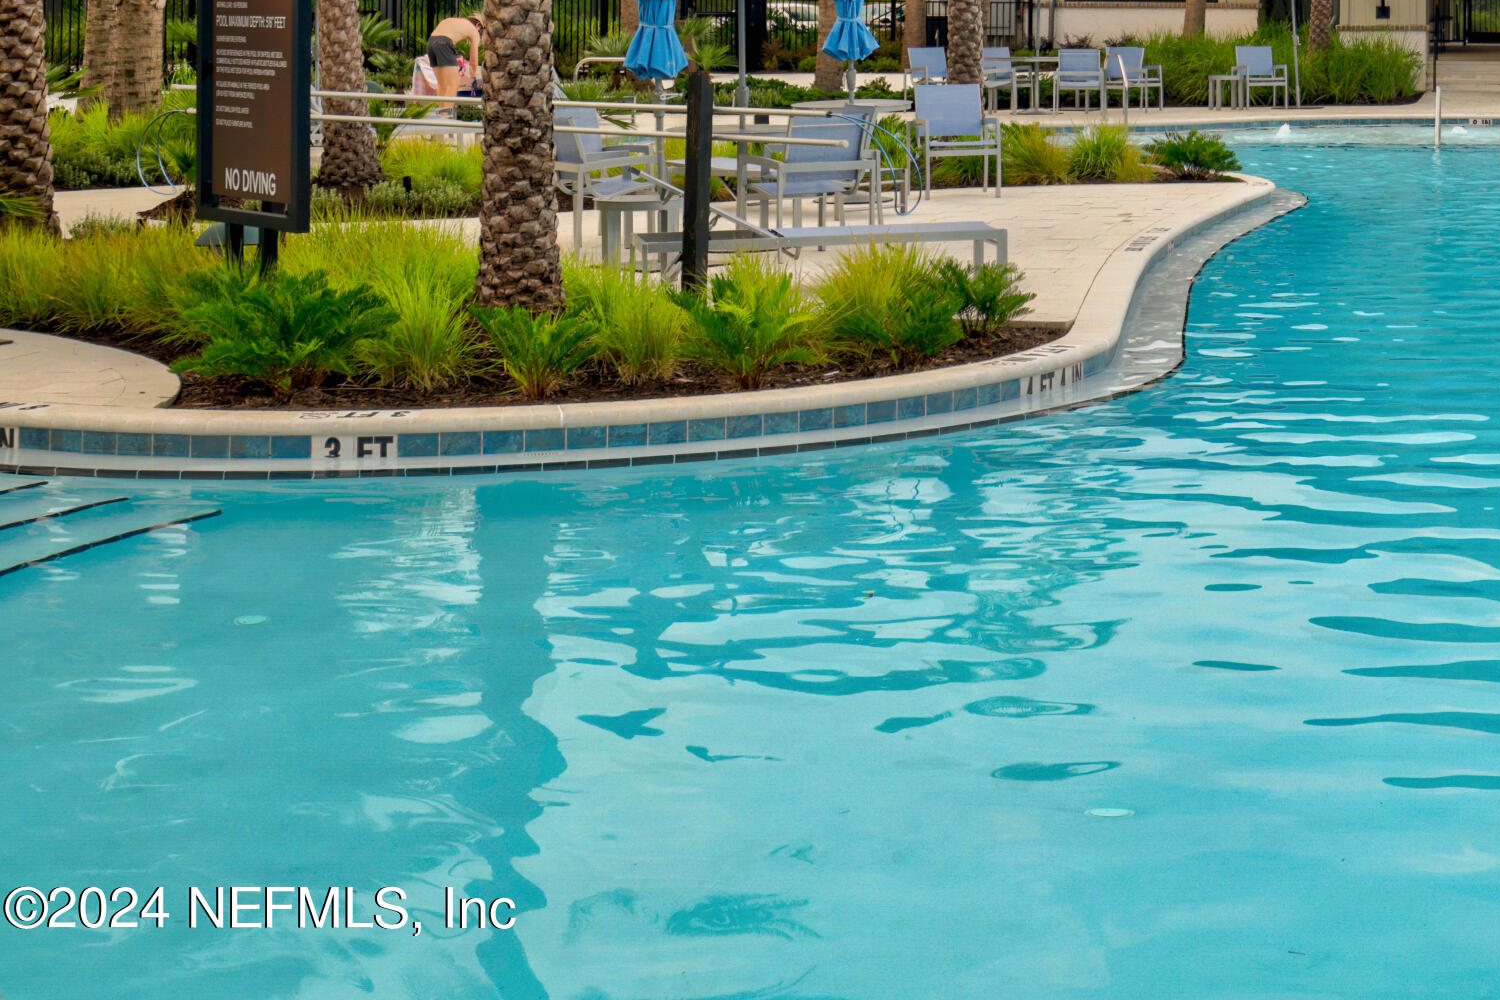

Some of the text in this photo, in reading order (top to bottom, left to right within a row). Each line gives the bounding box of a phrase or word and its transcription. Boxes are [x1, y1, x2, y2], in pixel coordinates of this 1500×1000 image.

[216, 14, 228, 27] POOL
[228, 15, 249, 28] MAXIMUM
[274, 16, 286, 29] FEET
[225, 167, 276, 197] NO DIVING
[1040, 371, 1055, 392] FT
[1072, 361, 1082, 383] IN
[357, 436, 394, 458] FT
